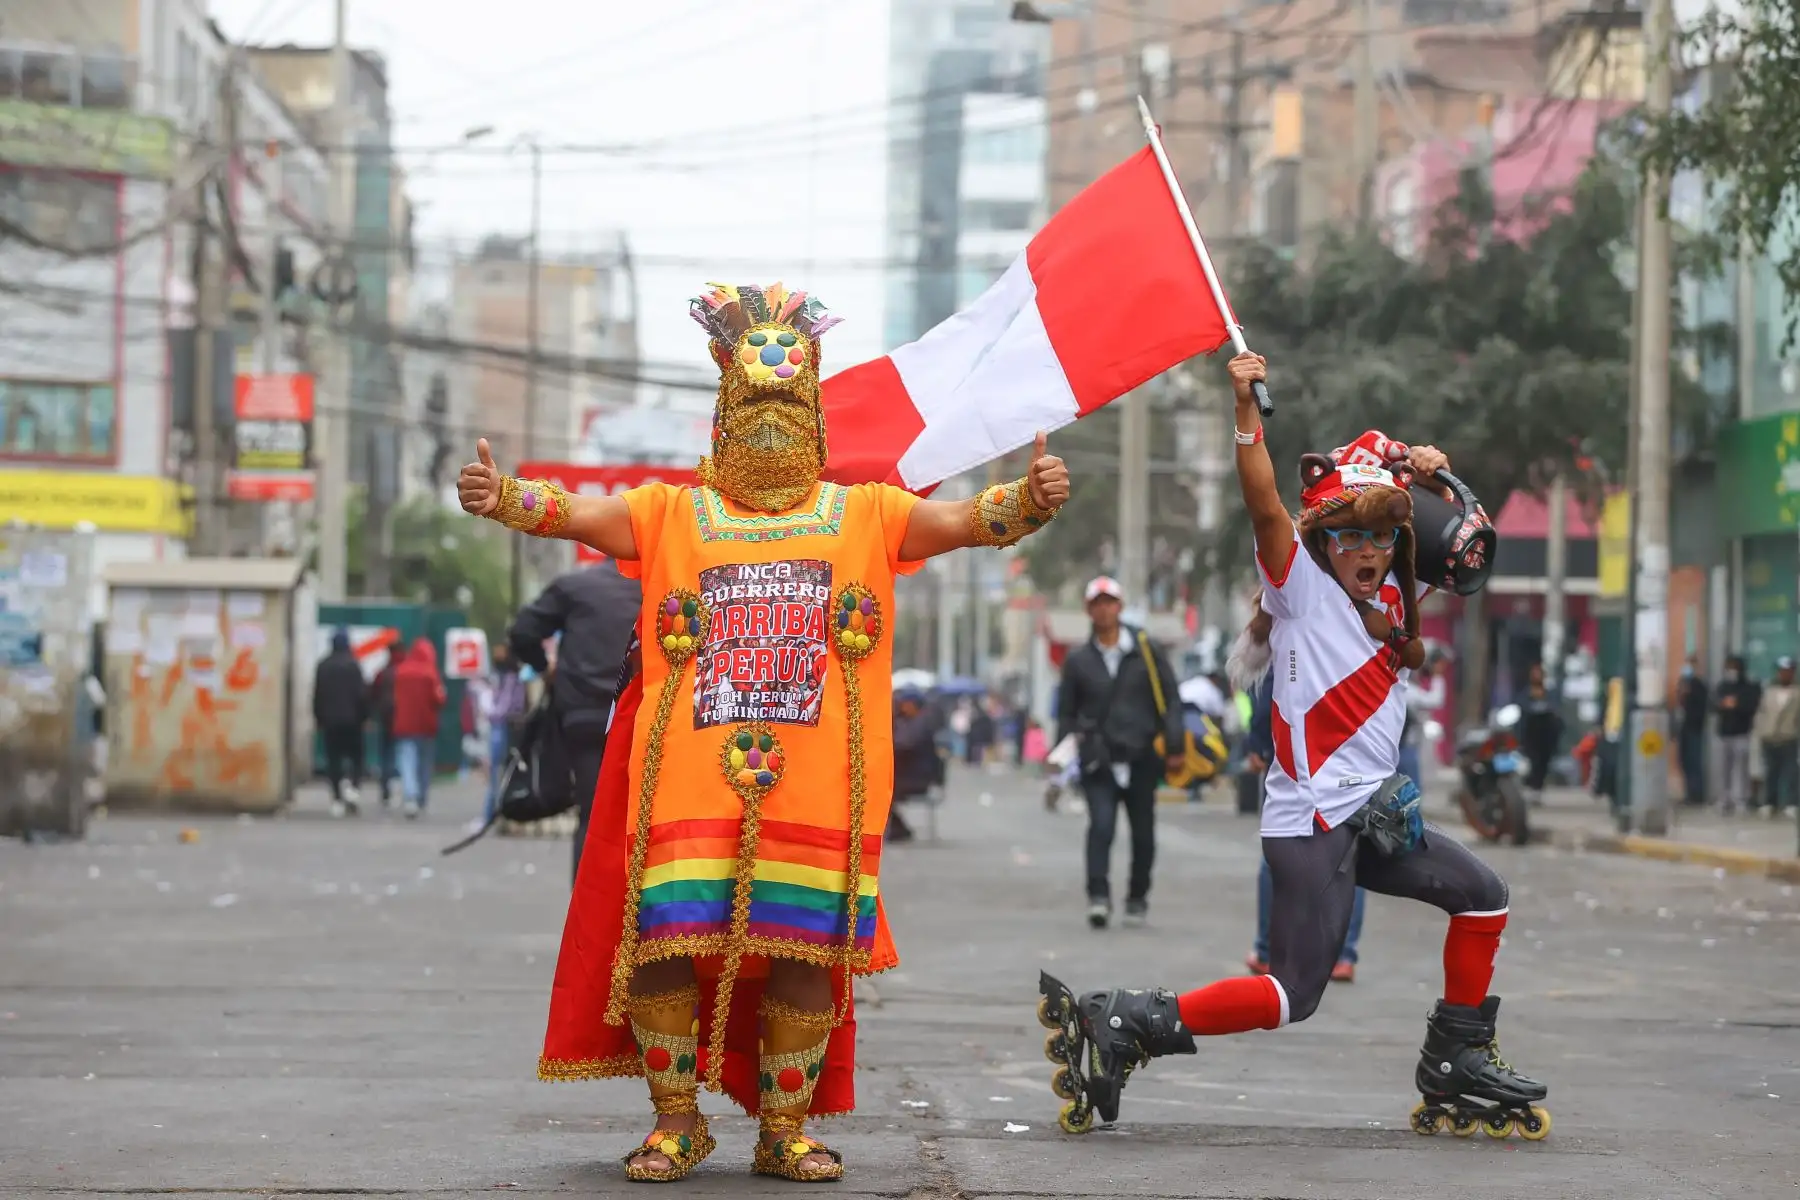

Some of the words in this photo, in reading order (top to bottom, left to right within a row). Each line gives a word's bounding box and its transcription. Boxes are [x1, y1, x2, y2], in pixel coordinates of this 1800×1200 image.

[738, 563, 792, 580] INCA
[701, 582, 829, 607] GUERRERO
[707, 602, 826, 646] ARRIBA
[701, 708, 722, 723] TU
[728, 706, 810, 721] HINCHADA
